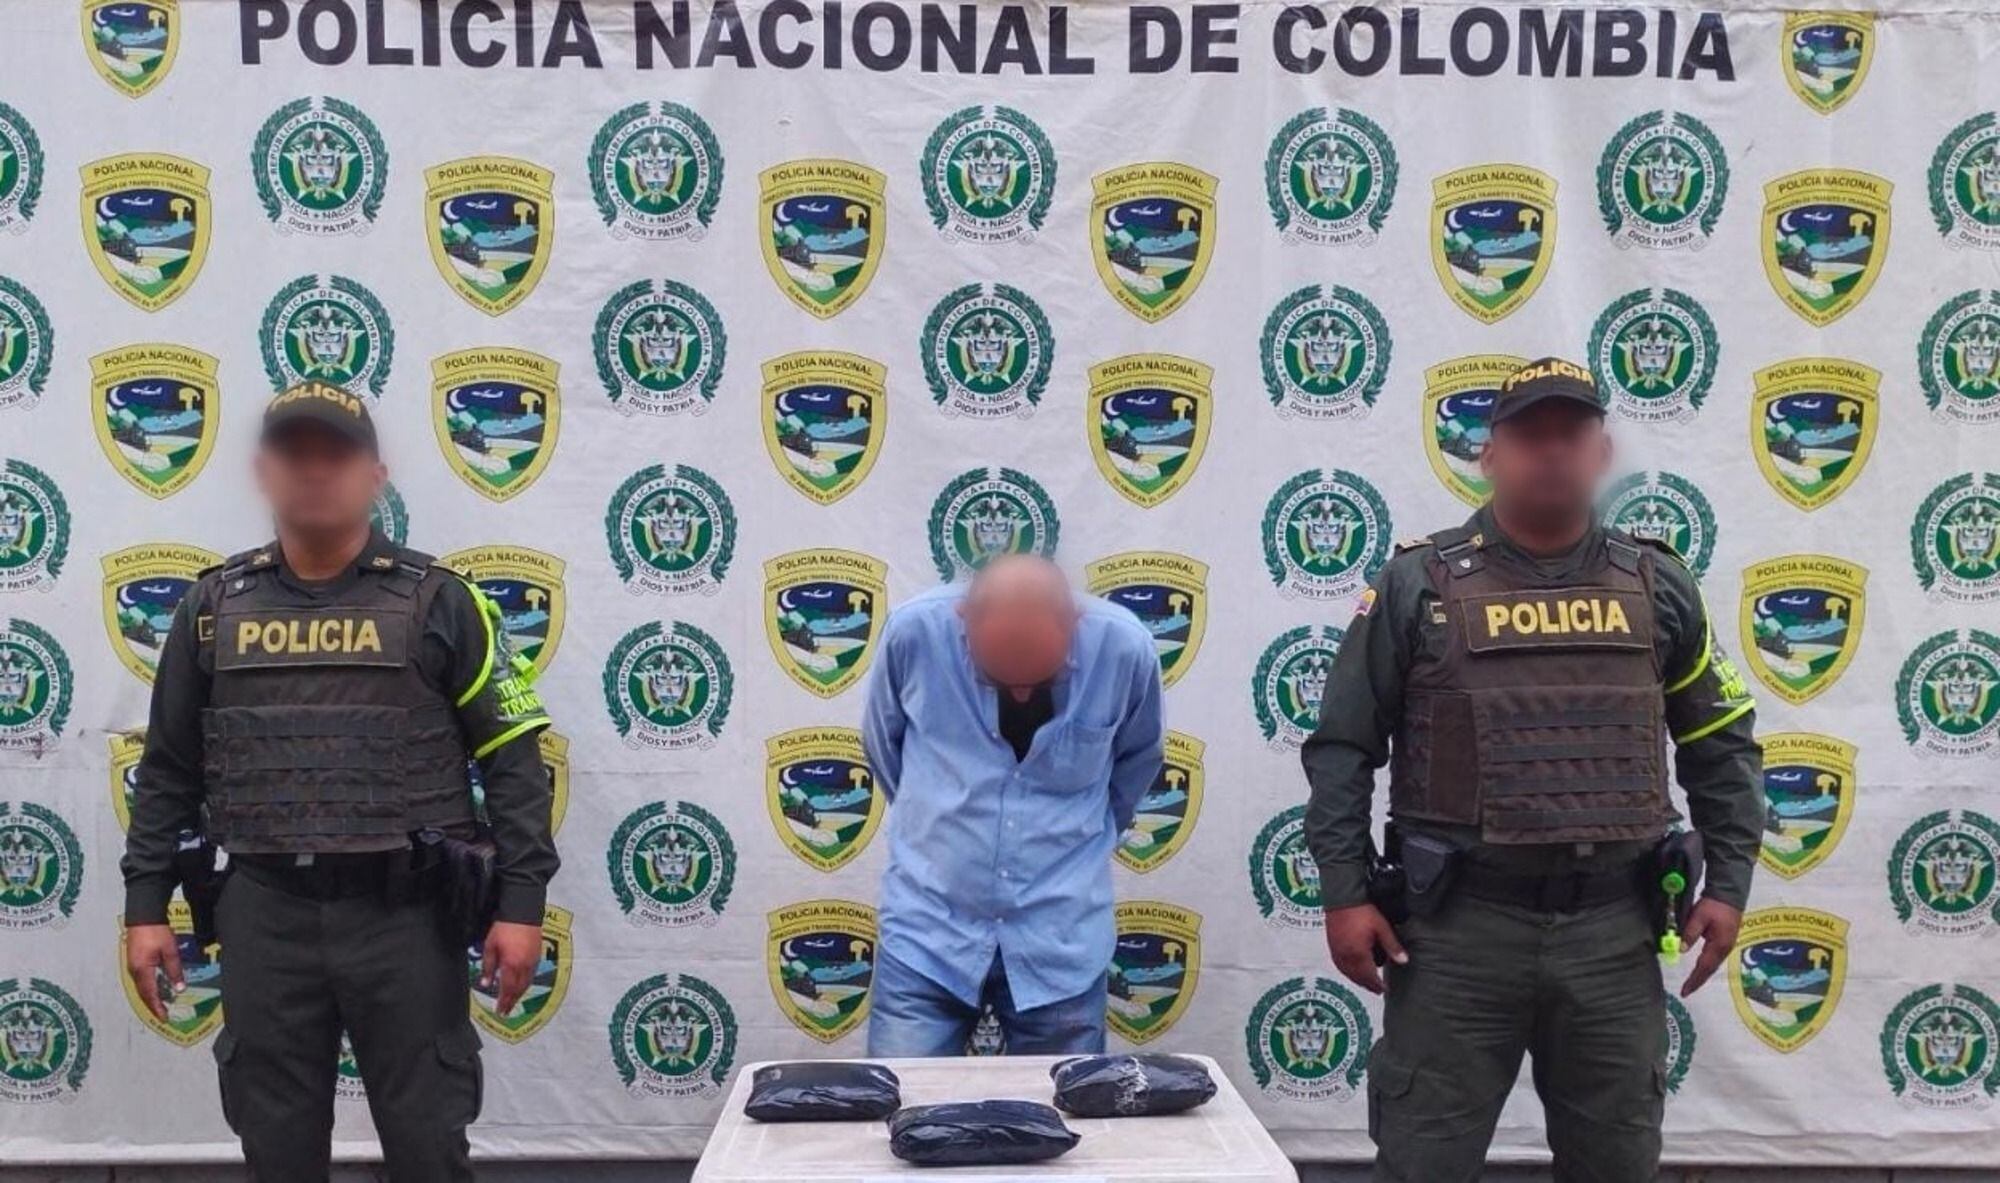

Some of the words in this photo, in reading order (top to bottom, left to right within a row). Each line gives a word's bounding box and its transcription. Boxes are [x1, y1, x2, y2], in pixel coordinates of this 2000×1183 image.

[241, 0, 602, 68] POLICIA
[634, 0, 1094, 75] NACIONAL
[1129, 5, 1239, 74] DE
[1273, 5, 1735, 81] COLOMBIA
[270, 118, 302, 174] REPUBLICA
[339, 119, 372, 173] COLOMBIA
[606, 122, 639, 178] REPUBLICA
[675, 123, 707, 177] COLOMBIA
[938, 126, 972, 181] REPUBLICA
[1009, 127, 1041, 182] COLOMBIA
[1282, 128, 1316, 182] REPUBLICA
[1351, 129, 1382, 184] COLOMBIA
[1616, 132, 1651, 186] REPUBLICA
[1686, 133, 1714, 188] COLOMBIA
[94, 160, 135, 177] POLICIA
[140, 160, 194, 177] NACIONAL
[439, 163, 479, 180] POLICIA
[484, 163, 538, 181] NACIONAL
[772, 166, 813, 182] POLICIA
[818, 166, 871, 184] NACIONAL
[1106, 170, 1146, 187] POLICIA
[1151, 169, 1202, 187] NACIONAL
[1446, 172, 1487, 189] POLICIA
[1492, 171, 1545, 188] NACIONAL
[1779, 176, 1820, 193] POLICIA
[1825, 176, 1878, 193] NACIONAL
[275, 188, 311, 218] POLICIA
[323, 187, 368, 219] NACIONAL
[610, 192, 645, 222] POLICIA
[658, 191, 703, 223] NACIONAL
[942, 195, 977, 226] POLICIA
[989, 195, 1035, 227] NACIONAL
[1285, 197, 1318, 228] POLICIA
[1330, 198, 1376, 229] NACIONAL
[1617, 200, 1650, 232] POLICIA
[1662, 202, 1707, 233] NACIONAL
[323, 218, 357, 233] PATRIA
[658, 222, 692, 237] PATRIA
[989, 226, 1023, 240] PATRIA
[1329, 229, 1363, 243] PATRIA
[1660, 233, 1694, 246] PATRIA
[938, 304, 972, 358] REPUBLICA
[1007, 304, 1038, 358] COLOMBIA
[1276, 305, 1310, 359] REPUBLICA
[1345, 306, 1375, 360] COLOMBIA
[104, 351, 145, 367] POLICIA
[149, 350, 203, 367] NACIONAL
[445, 354, 486, 370] POLICIA
[491, 354, 545, 371] NACIONAL
[775, 357, 815, 373] POLICIA
[819, 357, 872, 375] NACIONAL
[1102, 361, 1141, 377] POLICIA
[1146, 361, 1198, 377] NACIONAL
[1437, 362, 1480, 379] POLICIA
[1768, 364, 1809, 381] POLICIA
[1814, 364, 1865, 381] NACIONAL
[942, 371, 976, 402] POLICIA
[988, 371, 1033, 403] NACIONAL
[1279, 373, 1312, 403] POLICIA
[1324, 373, 1369, 404] NACIONAL
[270, 382, 362, 418] POLICIA
[988, 402, 1022, 416] PATRIA
[1323, 404, 1357, 417] PATRIA
[21, 479, 55, 532] COLOMBIA
[623, 484, 655, 536] REPUBLICA
[690, 485, 721, 536] COLOMBIA
[8, 545, 52, 576] NACIONAL
[115, 550, 156, 567] POLICIA
[158, 549, 211, 566] NACIONAL
[496, 552, 551, 570] NACIONAL
[627, 550, 661, 579] POLICIA
[673, 549, 717, 580] NACIONAL
[778, 555, 817, 571] POLICIA
[822, 555, 872, 572] NACIONAL
[1099, 558, 1139, 572] POLICIA
[1142, 558, 1194, 576] NACIONAL
[1756, 562, 1796, 578] POLICIA
[1801, 562, 1852, 578] NACIONAL
[8, 575, 42, 589] PATRIA
[673, 579, 706, 593] PATRIA
[1484, 598, 1632, 638] POLICIA
[237, 618, 383, 655] POLICIA
[1913, 649, 1947, 700] REPUBLICA
[779, 733, 817, 749] POLICIA
[1789, 738, 1843, 755] NACIONAL
[1958, 742, 1992, 755] PATRIA
[35, 822, 68, 872] COLOMBIA
[624, 820, 656, 870] REPUBLICA
[690, 821, 721, 870] COLOMBIA
[628, 883, 662, 911] POLICIA
[673, 882, 717, 912] NACIONAL
[22, 914, 55, 927] PATRIA
[673, 911, 706, 924] PATRIA
[781, 907, 819, 922] POLICIA
[1135, 907, 1187, 924] NACIONAL
[1785, 914, 1834, 929] NACIONAL
